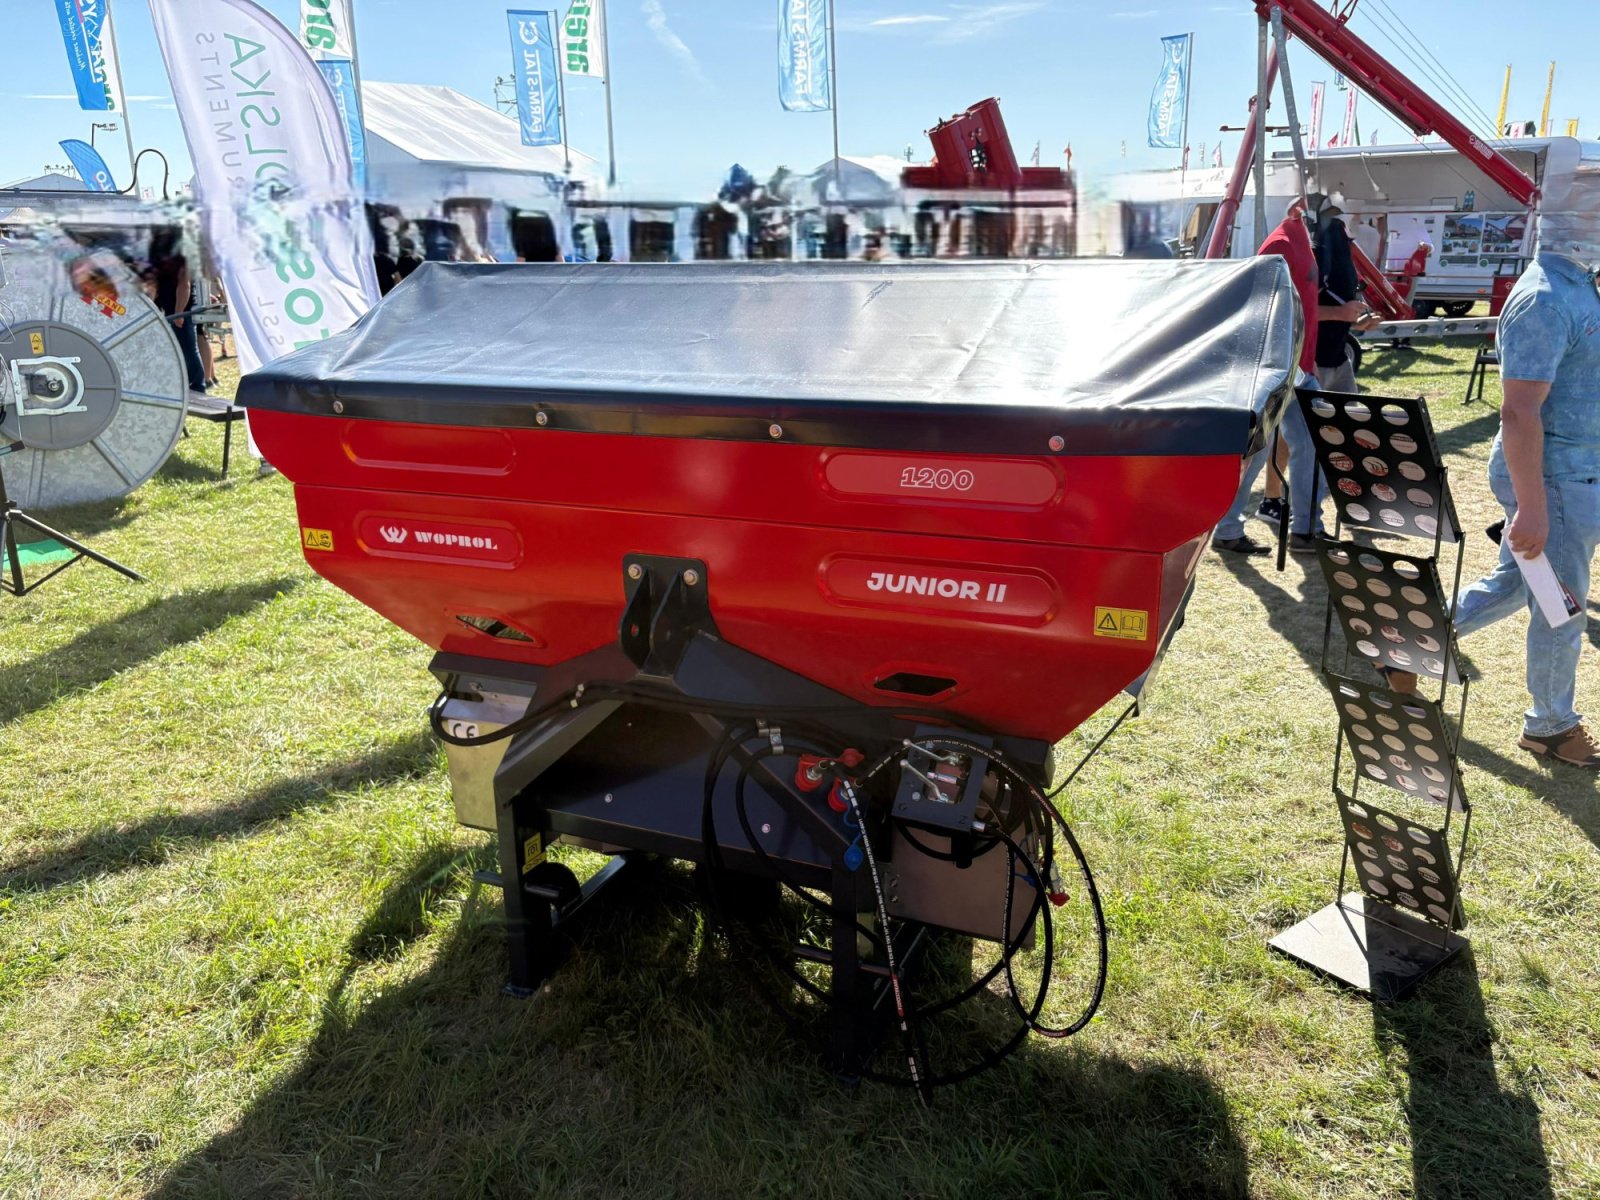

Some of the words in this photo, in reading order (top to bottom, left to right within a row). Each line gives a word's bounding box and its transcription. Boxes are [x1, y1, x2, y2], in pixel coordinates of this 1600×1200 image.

[900, 466, 974, 491] 1200
[414, 530, 498, 551] WOPROL
[866, 571, 980, 602] JUNIOR
[986, 583, 1007, 604] II
